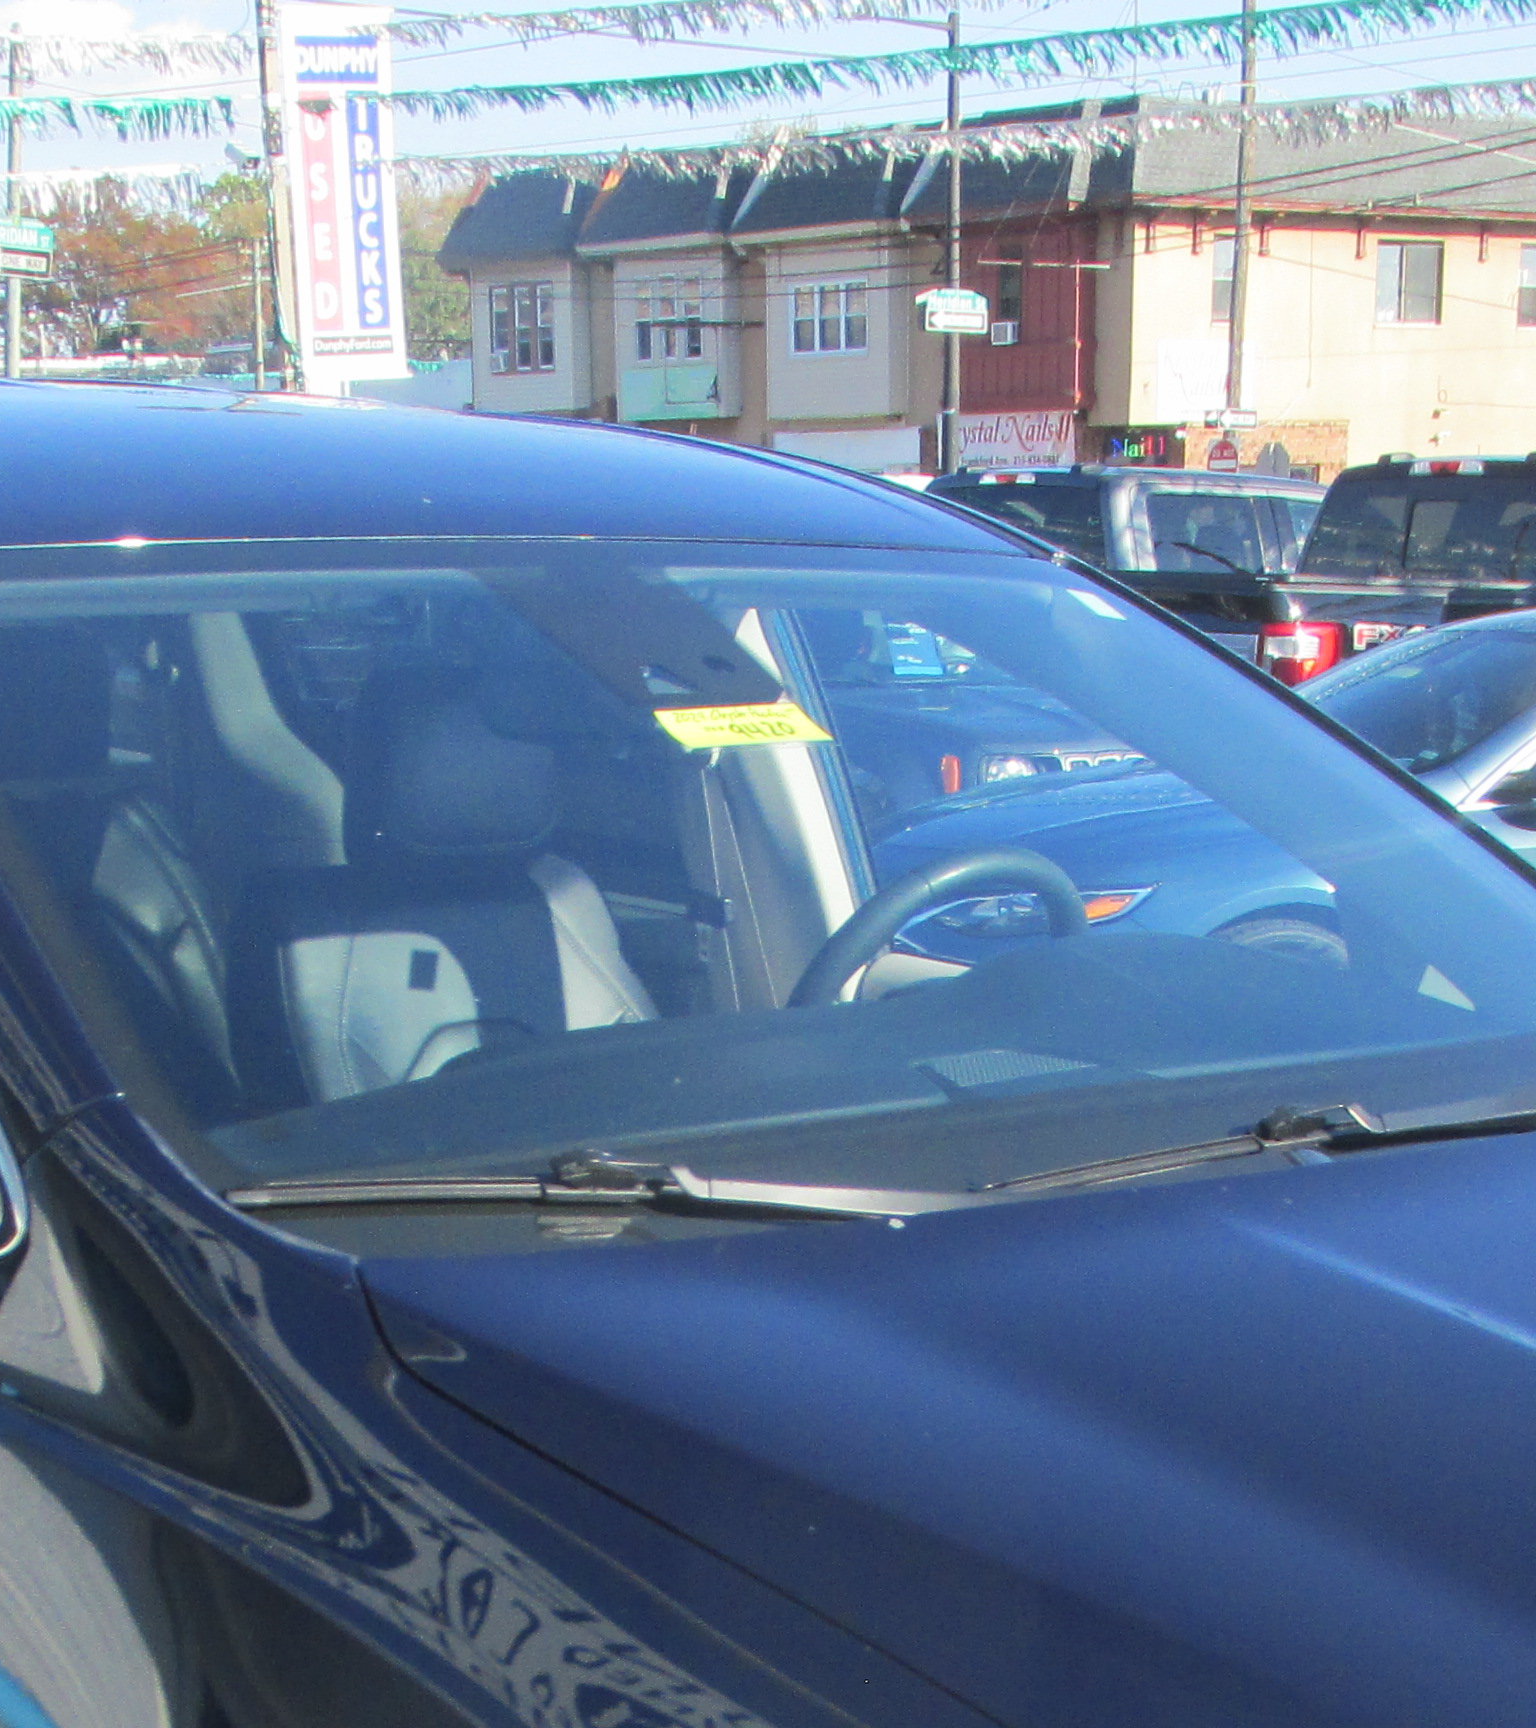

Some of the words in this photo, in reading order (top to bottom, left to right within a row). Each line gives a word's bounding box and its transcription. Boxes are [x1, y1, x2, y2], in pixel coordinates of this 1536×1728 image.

[297, 46, 378, 73] DUNPHY
[353, 97, 383, 324] TRUCKS
[315, 338, 392, 353] DunphyFord.com
[958, 416, 1000, 454] ystal
[1352, 621, 1428, 650] FX
